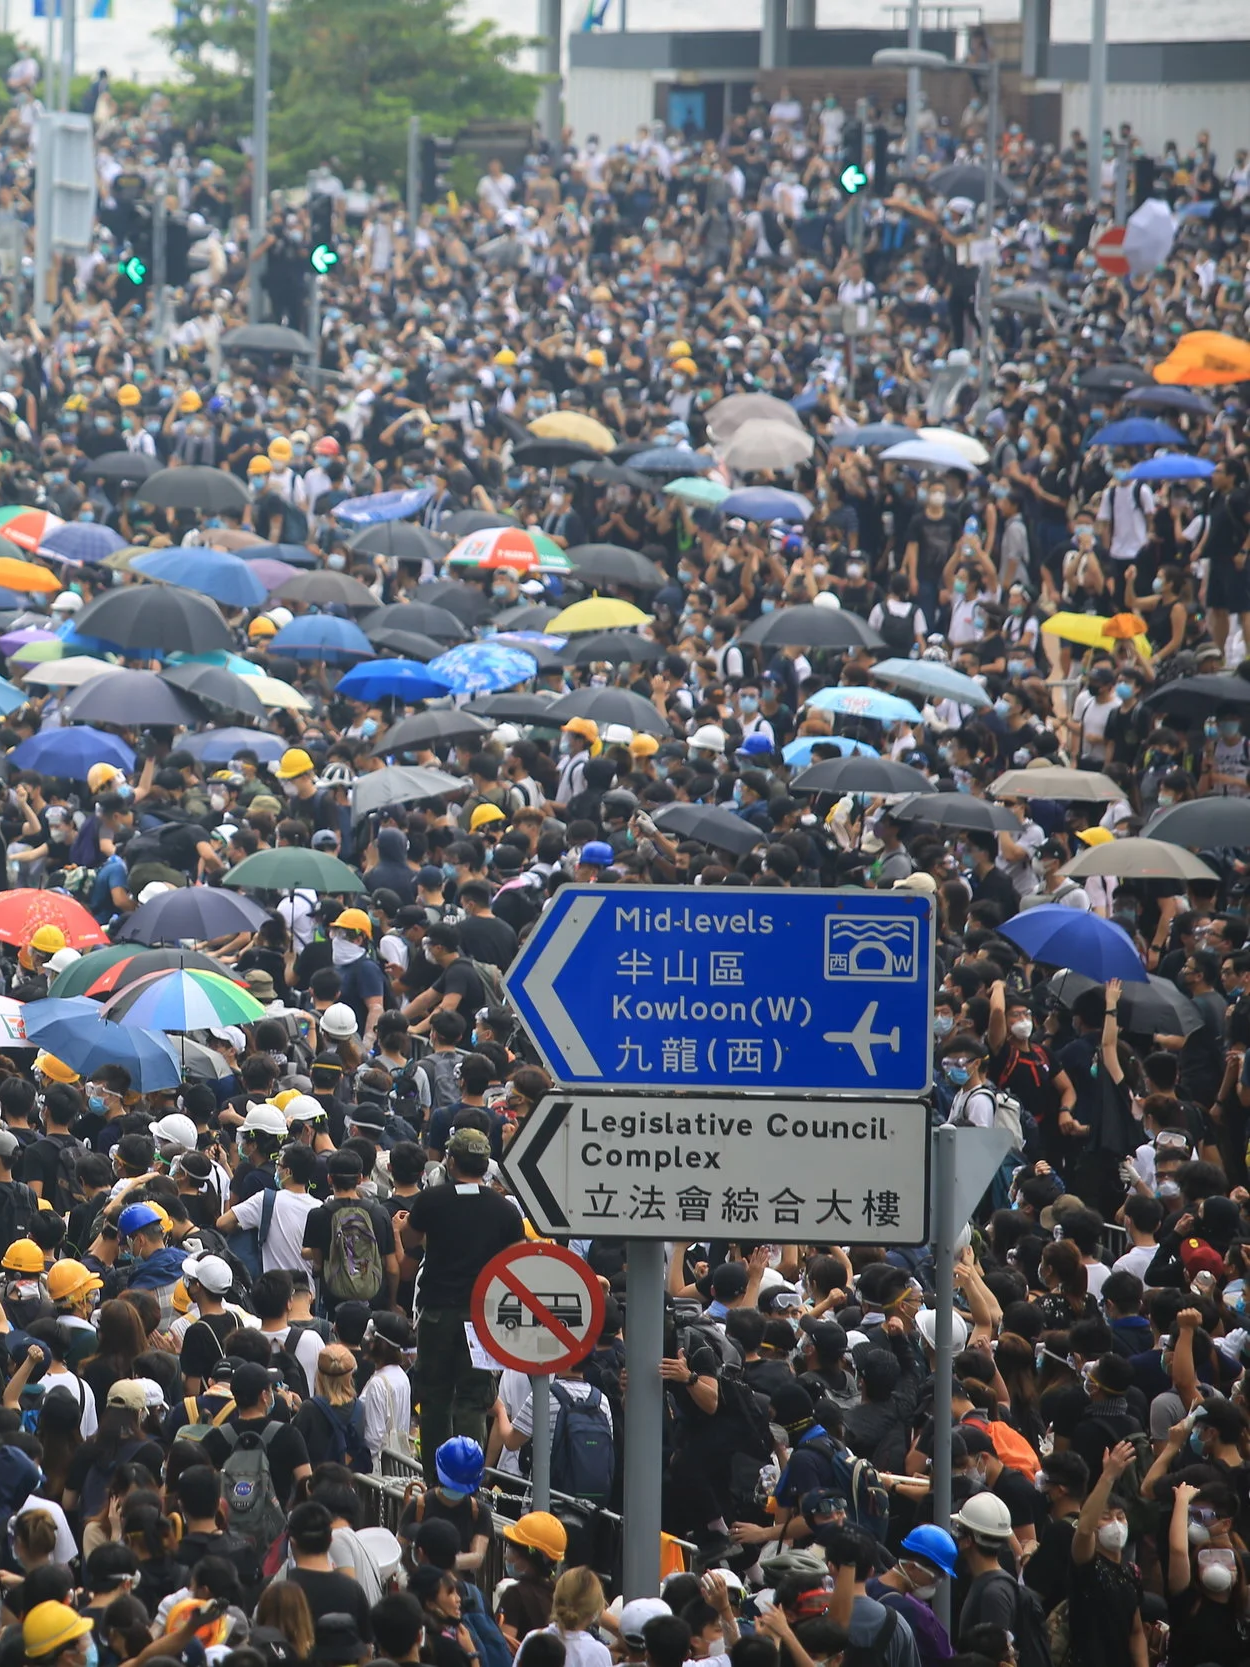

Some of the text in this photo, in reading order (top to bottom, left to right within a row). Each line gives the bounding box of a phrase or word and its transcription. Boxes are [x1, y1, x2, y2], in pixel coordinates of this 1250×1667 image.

[615, 907, 774, 934] Mid-levels
[616, 948, 745, 986] 半山區
[829, 953, 848, 972] 西
[892, 955, 912, 972] W
[612, 995, 812, 1027] Kowloon(W)
[615, 1036, 783, 1073] 九龍(西)
[581, 1108, 888, 1140] Legislative Council
[581, 1142, 721, 1172] Complex
[582, 1182, 901, 1227] 立法會綜合大樓
